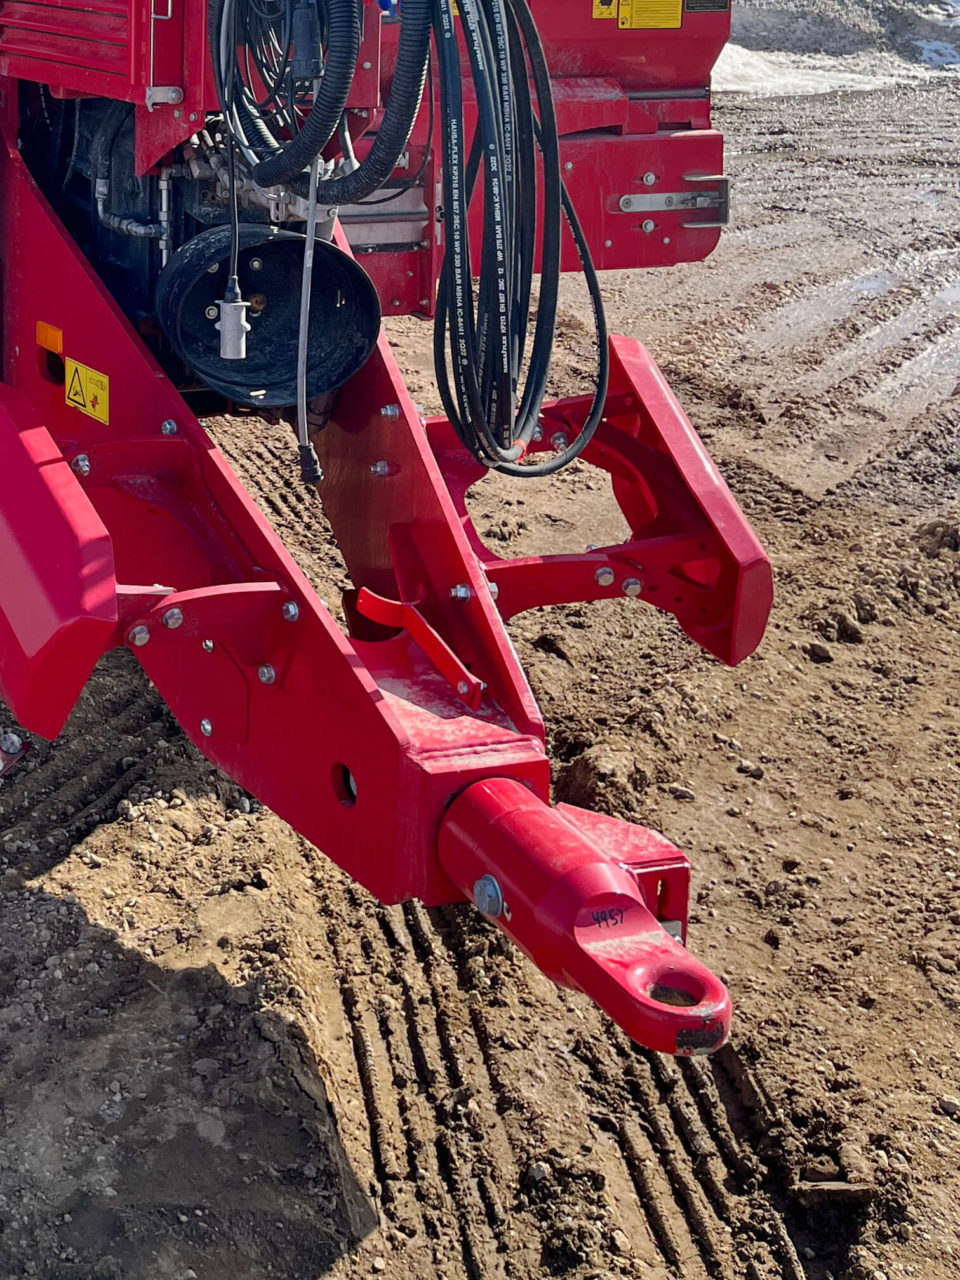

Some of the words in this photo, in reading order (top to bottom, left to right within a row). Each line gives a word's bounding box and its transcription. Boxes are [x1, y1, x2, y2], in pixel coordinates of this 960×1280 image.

[453, 189, 459, 199] EN
[493, 202, 501, 221] MSHA
[454, 241, 460, 253] WP
[497, 250, 503, 261] WP
[591, 908, 624, 928] 4957
